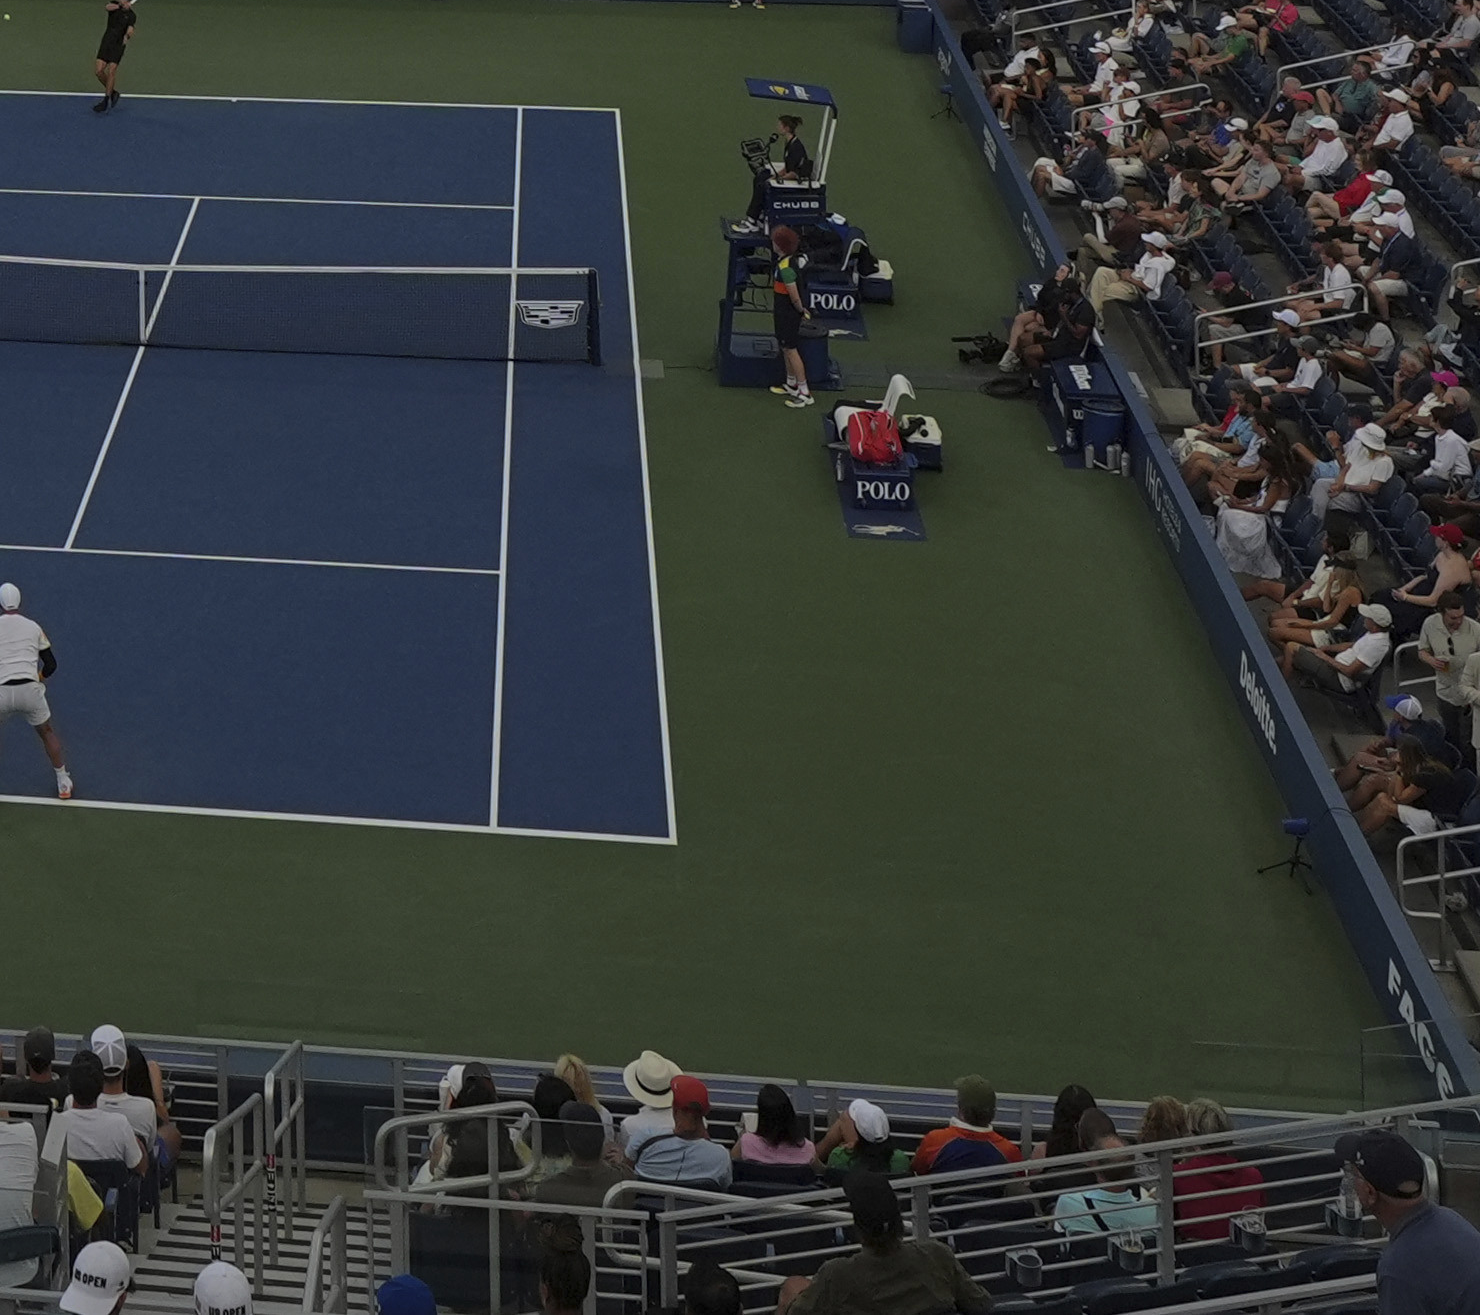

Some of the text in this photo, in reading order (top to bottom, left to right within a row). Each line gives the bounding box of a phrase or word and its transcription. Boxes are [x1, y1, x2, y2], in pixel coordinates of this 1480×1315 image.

[773, 201, 820, 209] CHUBB
[809, 292, 855, 311] POLO
[856, 480, 910, 501] POLO
[1239, 650, 1277, 755] Deloitte.
[74, 1268, 107, 1289] US OPEN
